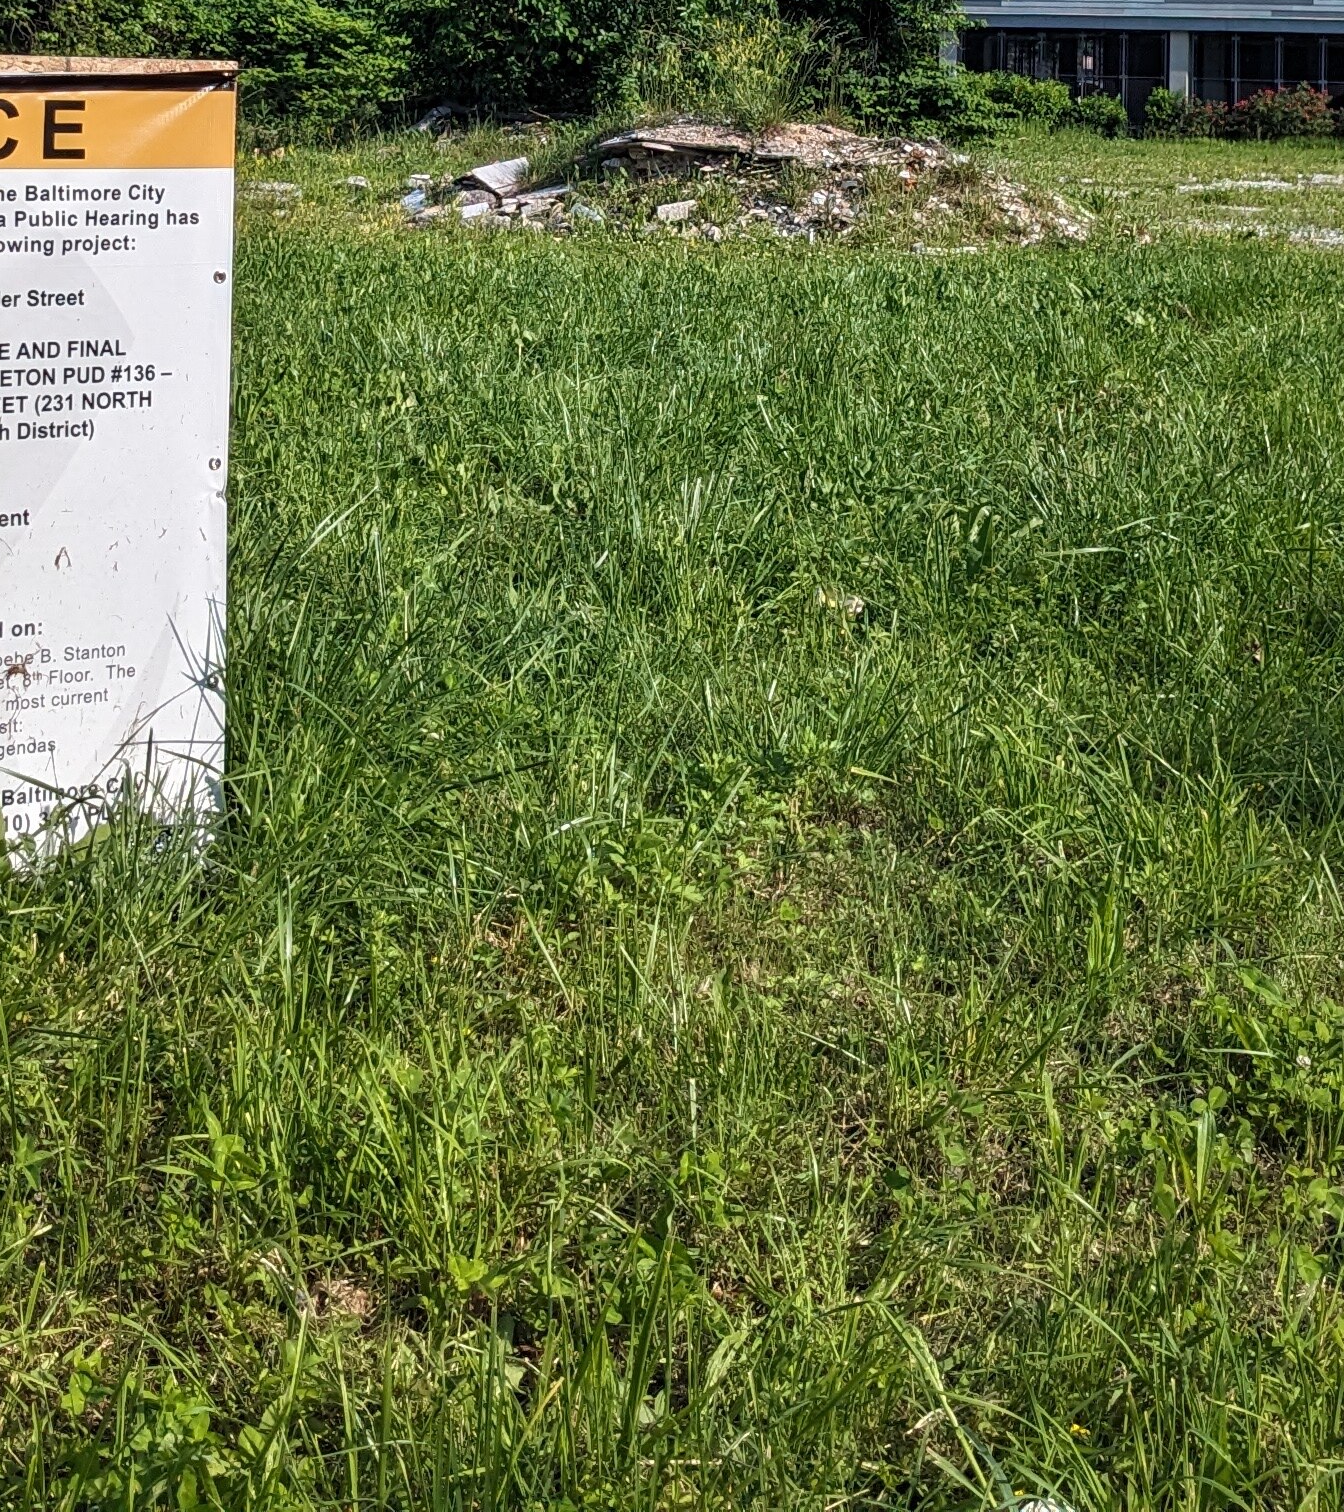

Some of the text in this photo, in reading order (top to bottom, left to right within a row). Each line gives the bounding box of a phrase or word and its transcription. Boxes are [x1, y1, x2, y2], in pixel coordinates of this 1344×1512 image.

[25, 184, 120, 202] Baltimore
[128, 185, 165, 205] City
[14, 209, 77, 227] Public
[85, 209, 158, 231] Hearing
[166, 209, 199, 226] has
[62, 235, 136, 257] project:
[27, 290, 84, 309] Street
[16, 342, 60, 360] AND
[68, 339, 126, 359] FINAL
[63, 367, 104, 385] PUD
[111, 365, 155, 383] #136
[35, 393, 74, 416] (231
[82, 390, 152, 411] NORTH
[18, 420, 95, 445] District)
[11, 623, 42, 637] on:
[41, 649, 56, 663] B.
[64, 644, 126, 661] Stanton
[49, 669, 94, 685] Floor.
[106, 665, 136, 680] The
[6, 697, 45, 711] most
[52, 688, 108, 706] current
